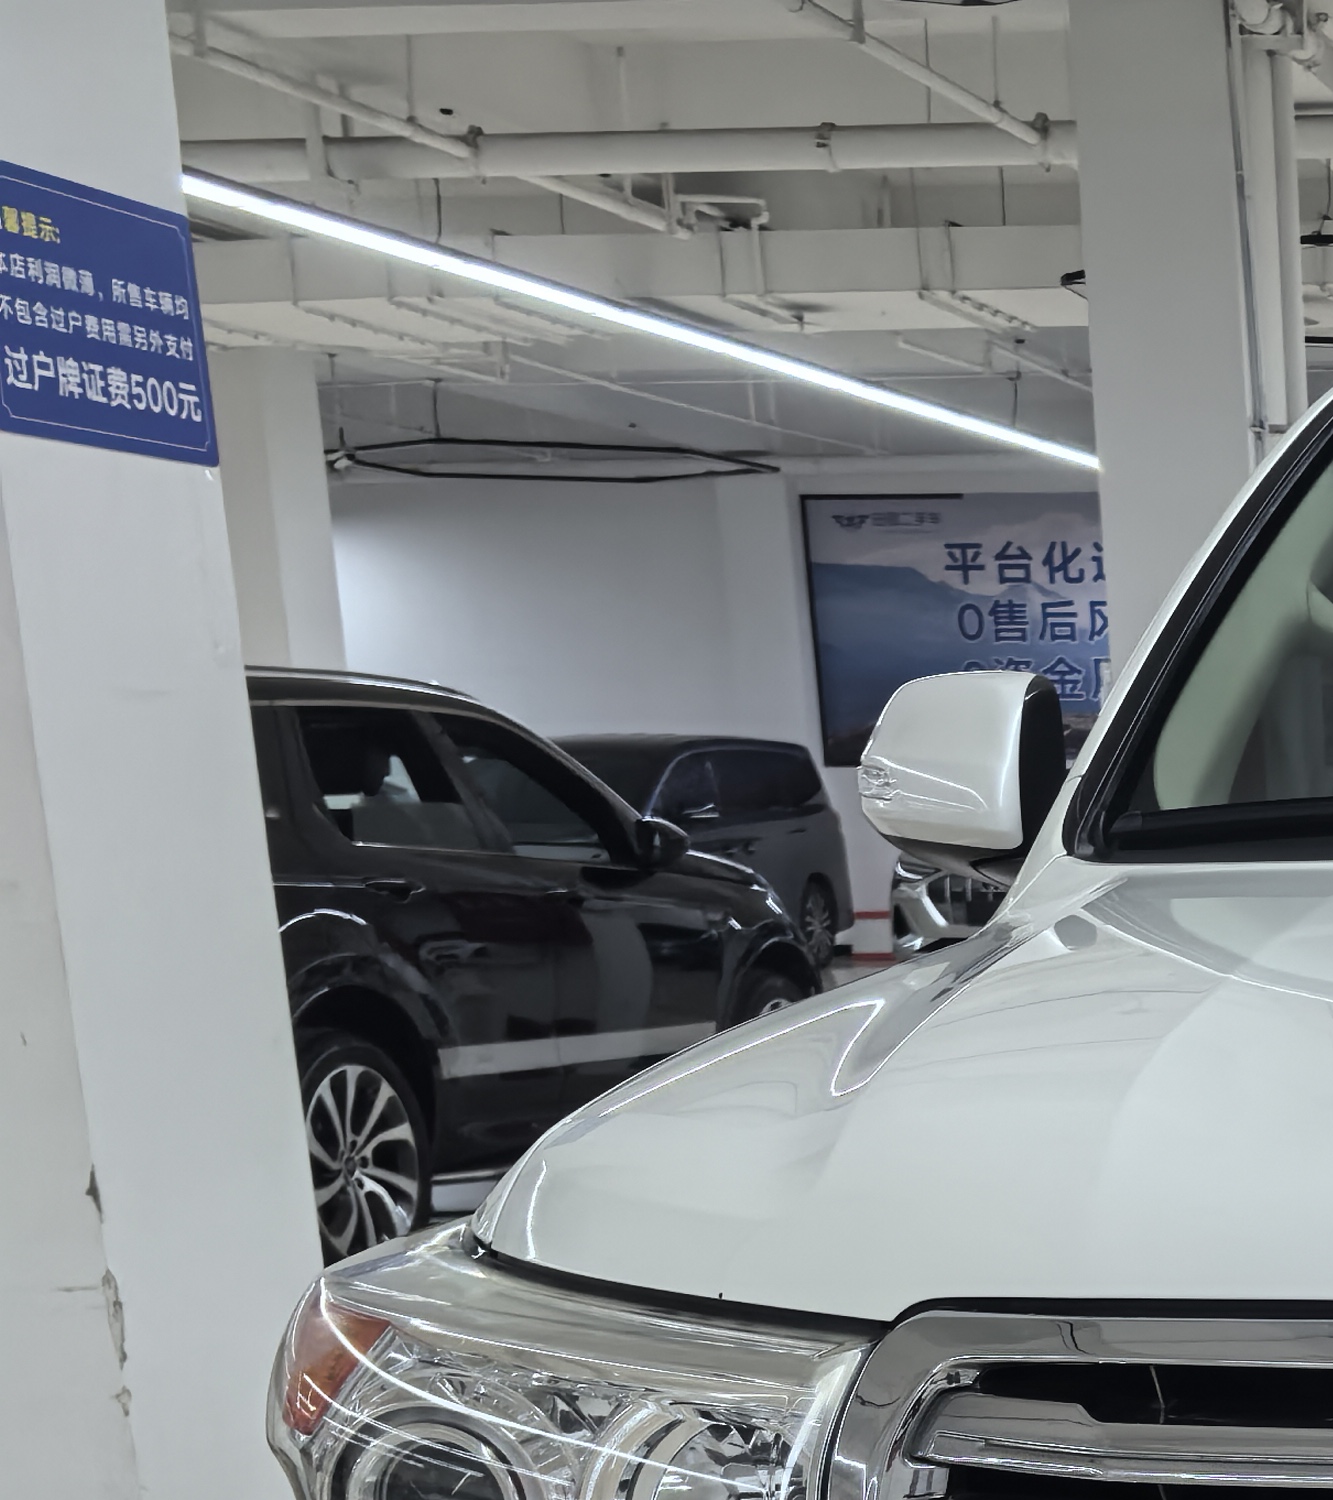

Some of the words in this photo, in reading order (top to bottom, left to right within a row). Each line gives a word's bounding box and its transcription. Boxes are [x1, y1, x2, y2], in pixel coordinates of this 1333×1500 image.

[4, 344, 202, 422] 过户牌证费500元
